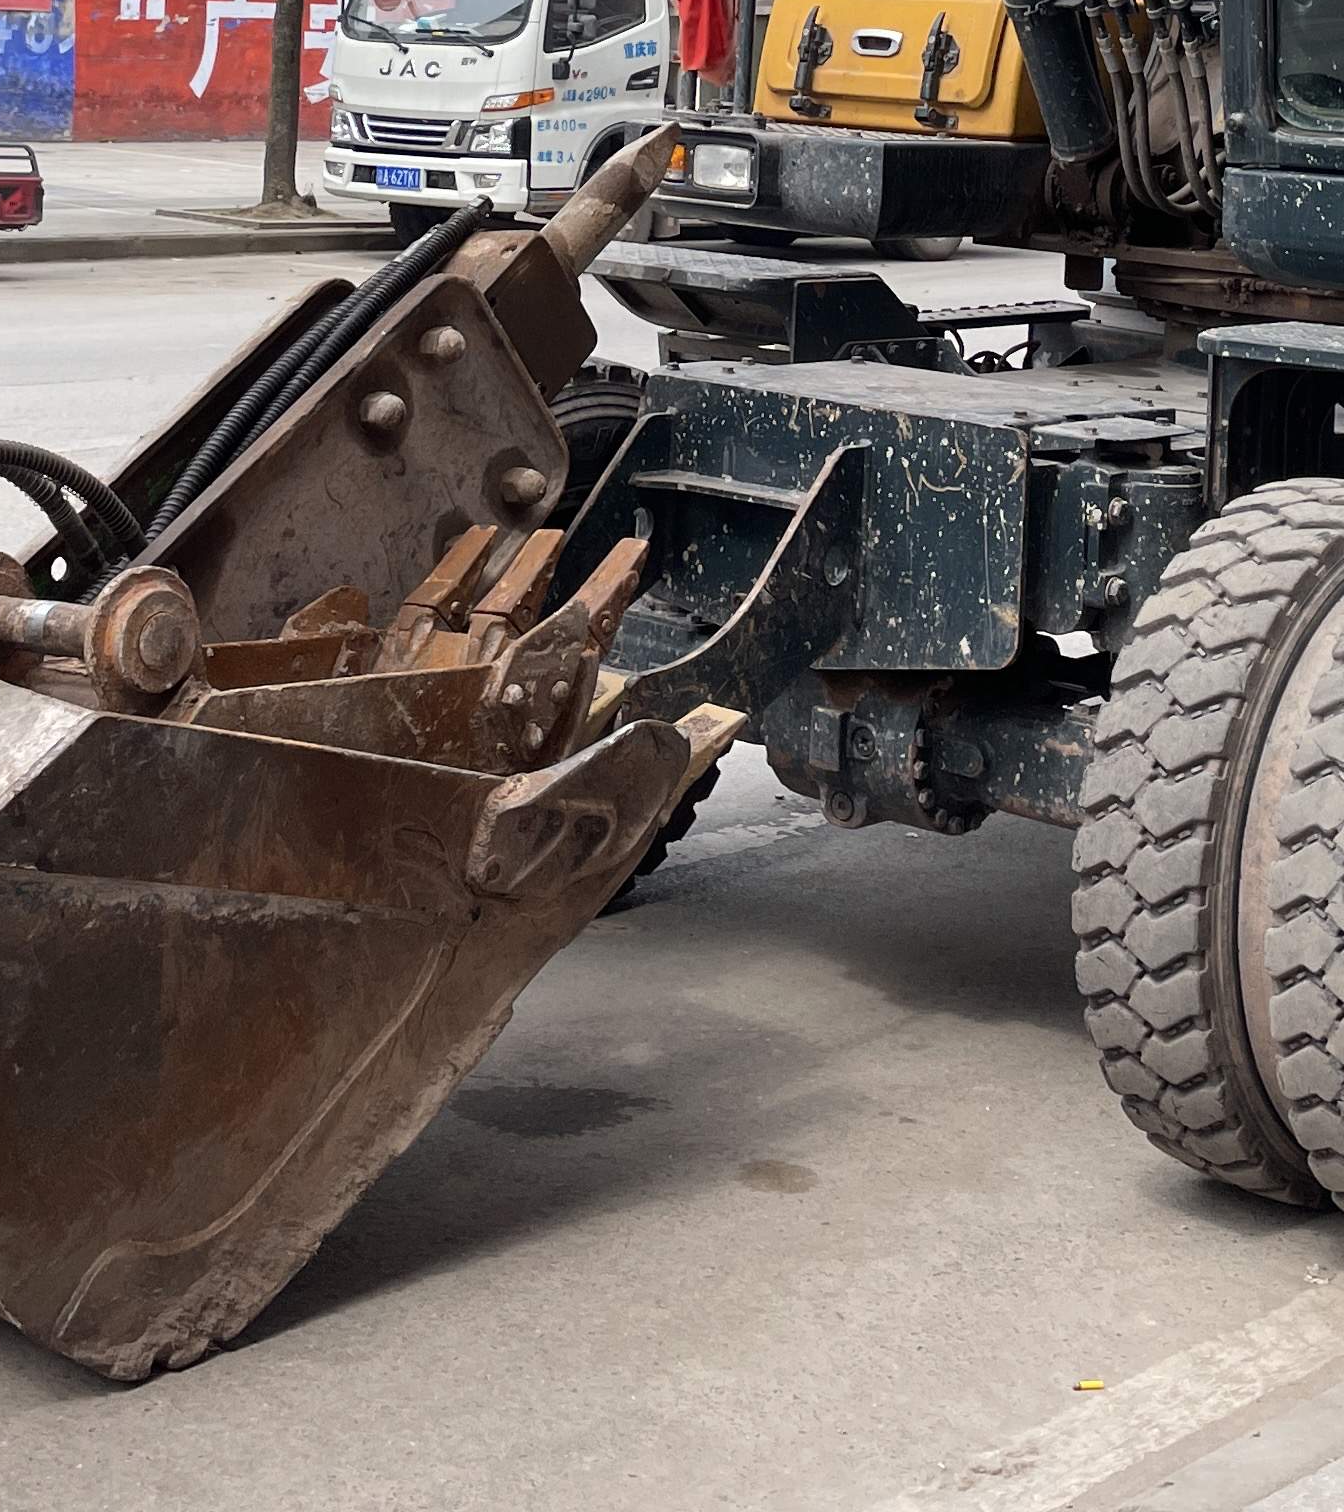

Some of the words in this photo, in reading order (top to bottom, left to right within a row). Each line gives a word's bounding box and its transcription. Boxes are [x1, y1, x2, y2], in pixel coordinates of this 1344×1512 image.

[623, 39, 657, 59] 重庆市
[379, 58, 442, 79] JAC
